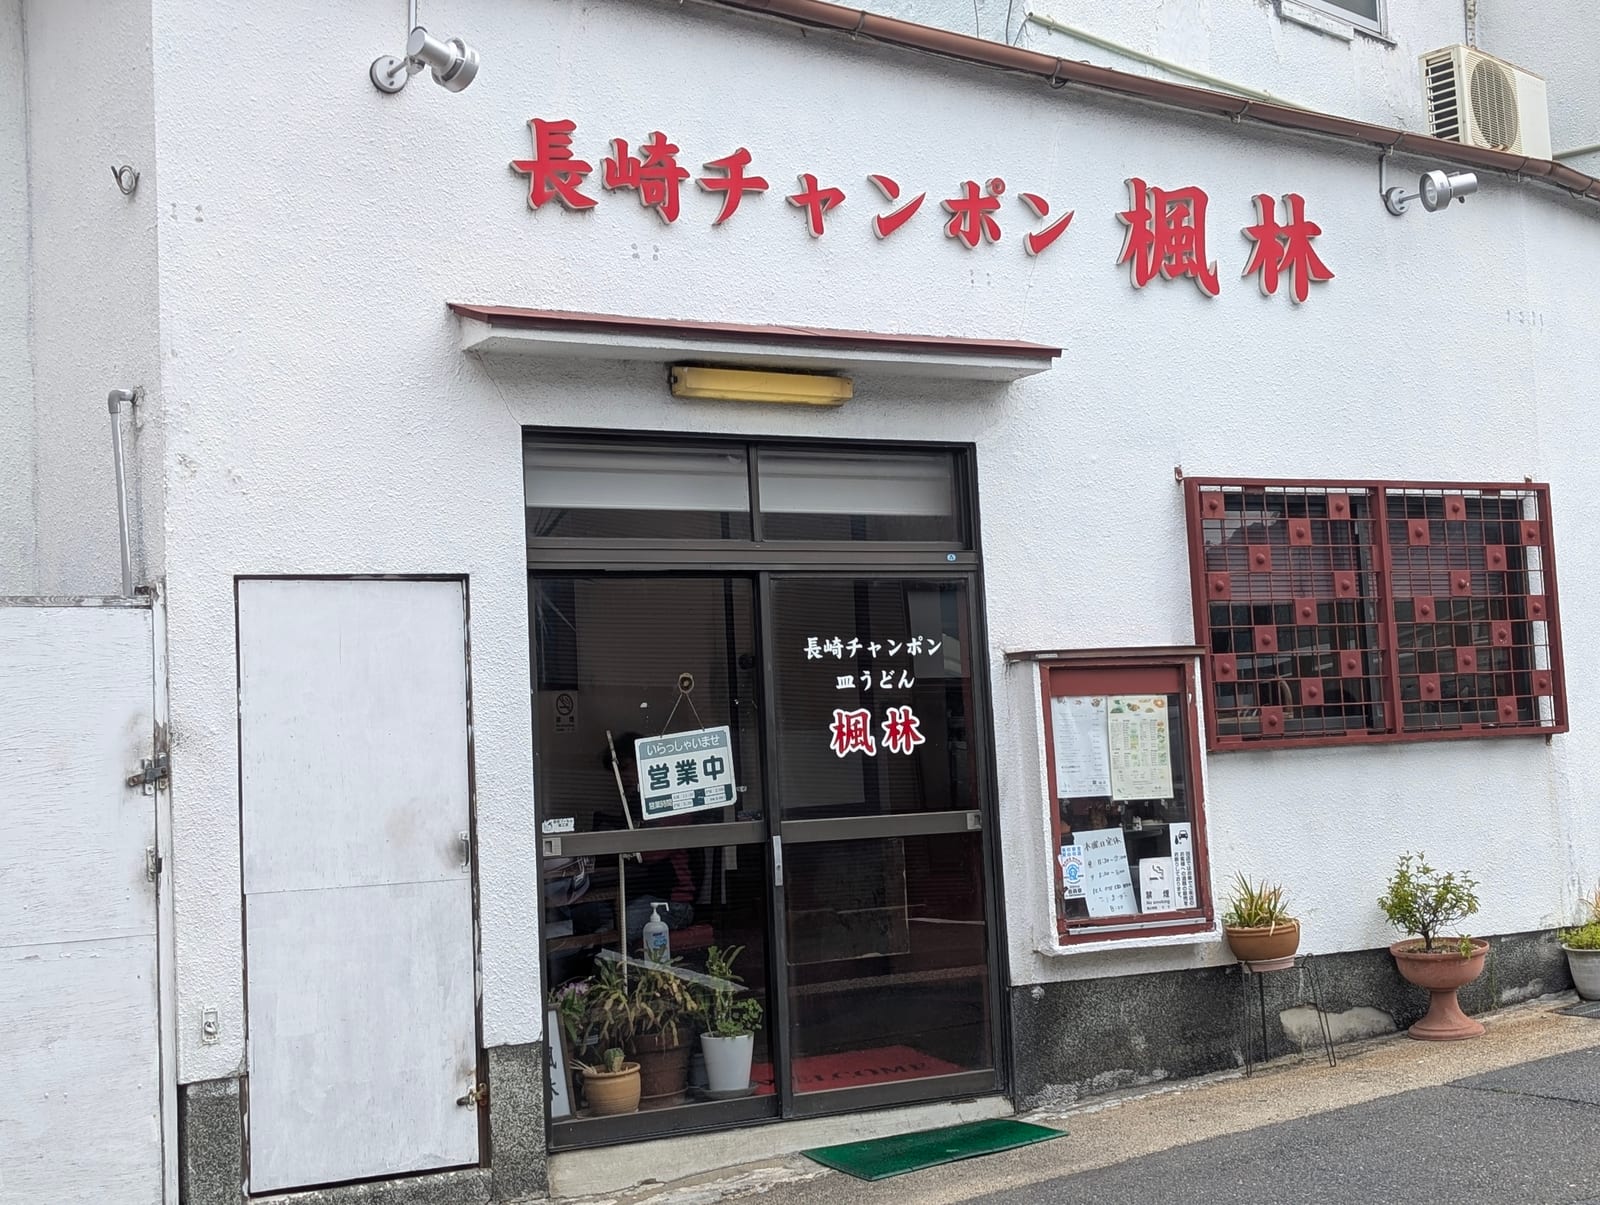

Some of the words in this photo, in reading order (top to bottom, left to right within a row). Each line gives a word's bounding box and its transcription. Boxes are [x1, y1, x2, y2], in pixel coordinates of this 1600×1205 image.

[511, 118, 1073, 256] 長崎チャンポン
[1117, 178, 1335, 303] 楓林
[803, 635, 942, 661] 長崎チャンポン
[835, 669, 915, 691] 皿うどん
[646, 734, 721, 756] いらっしゃいませ
[829, 705, 926, 758] 楓林
[647, 755, 725, 791] 営業中
